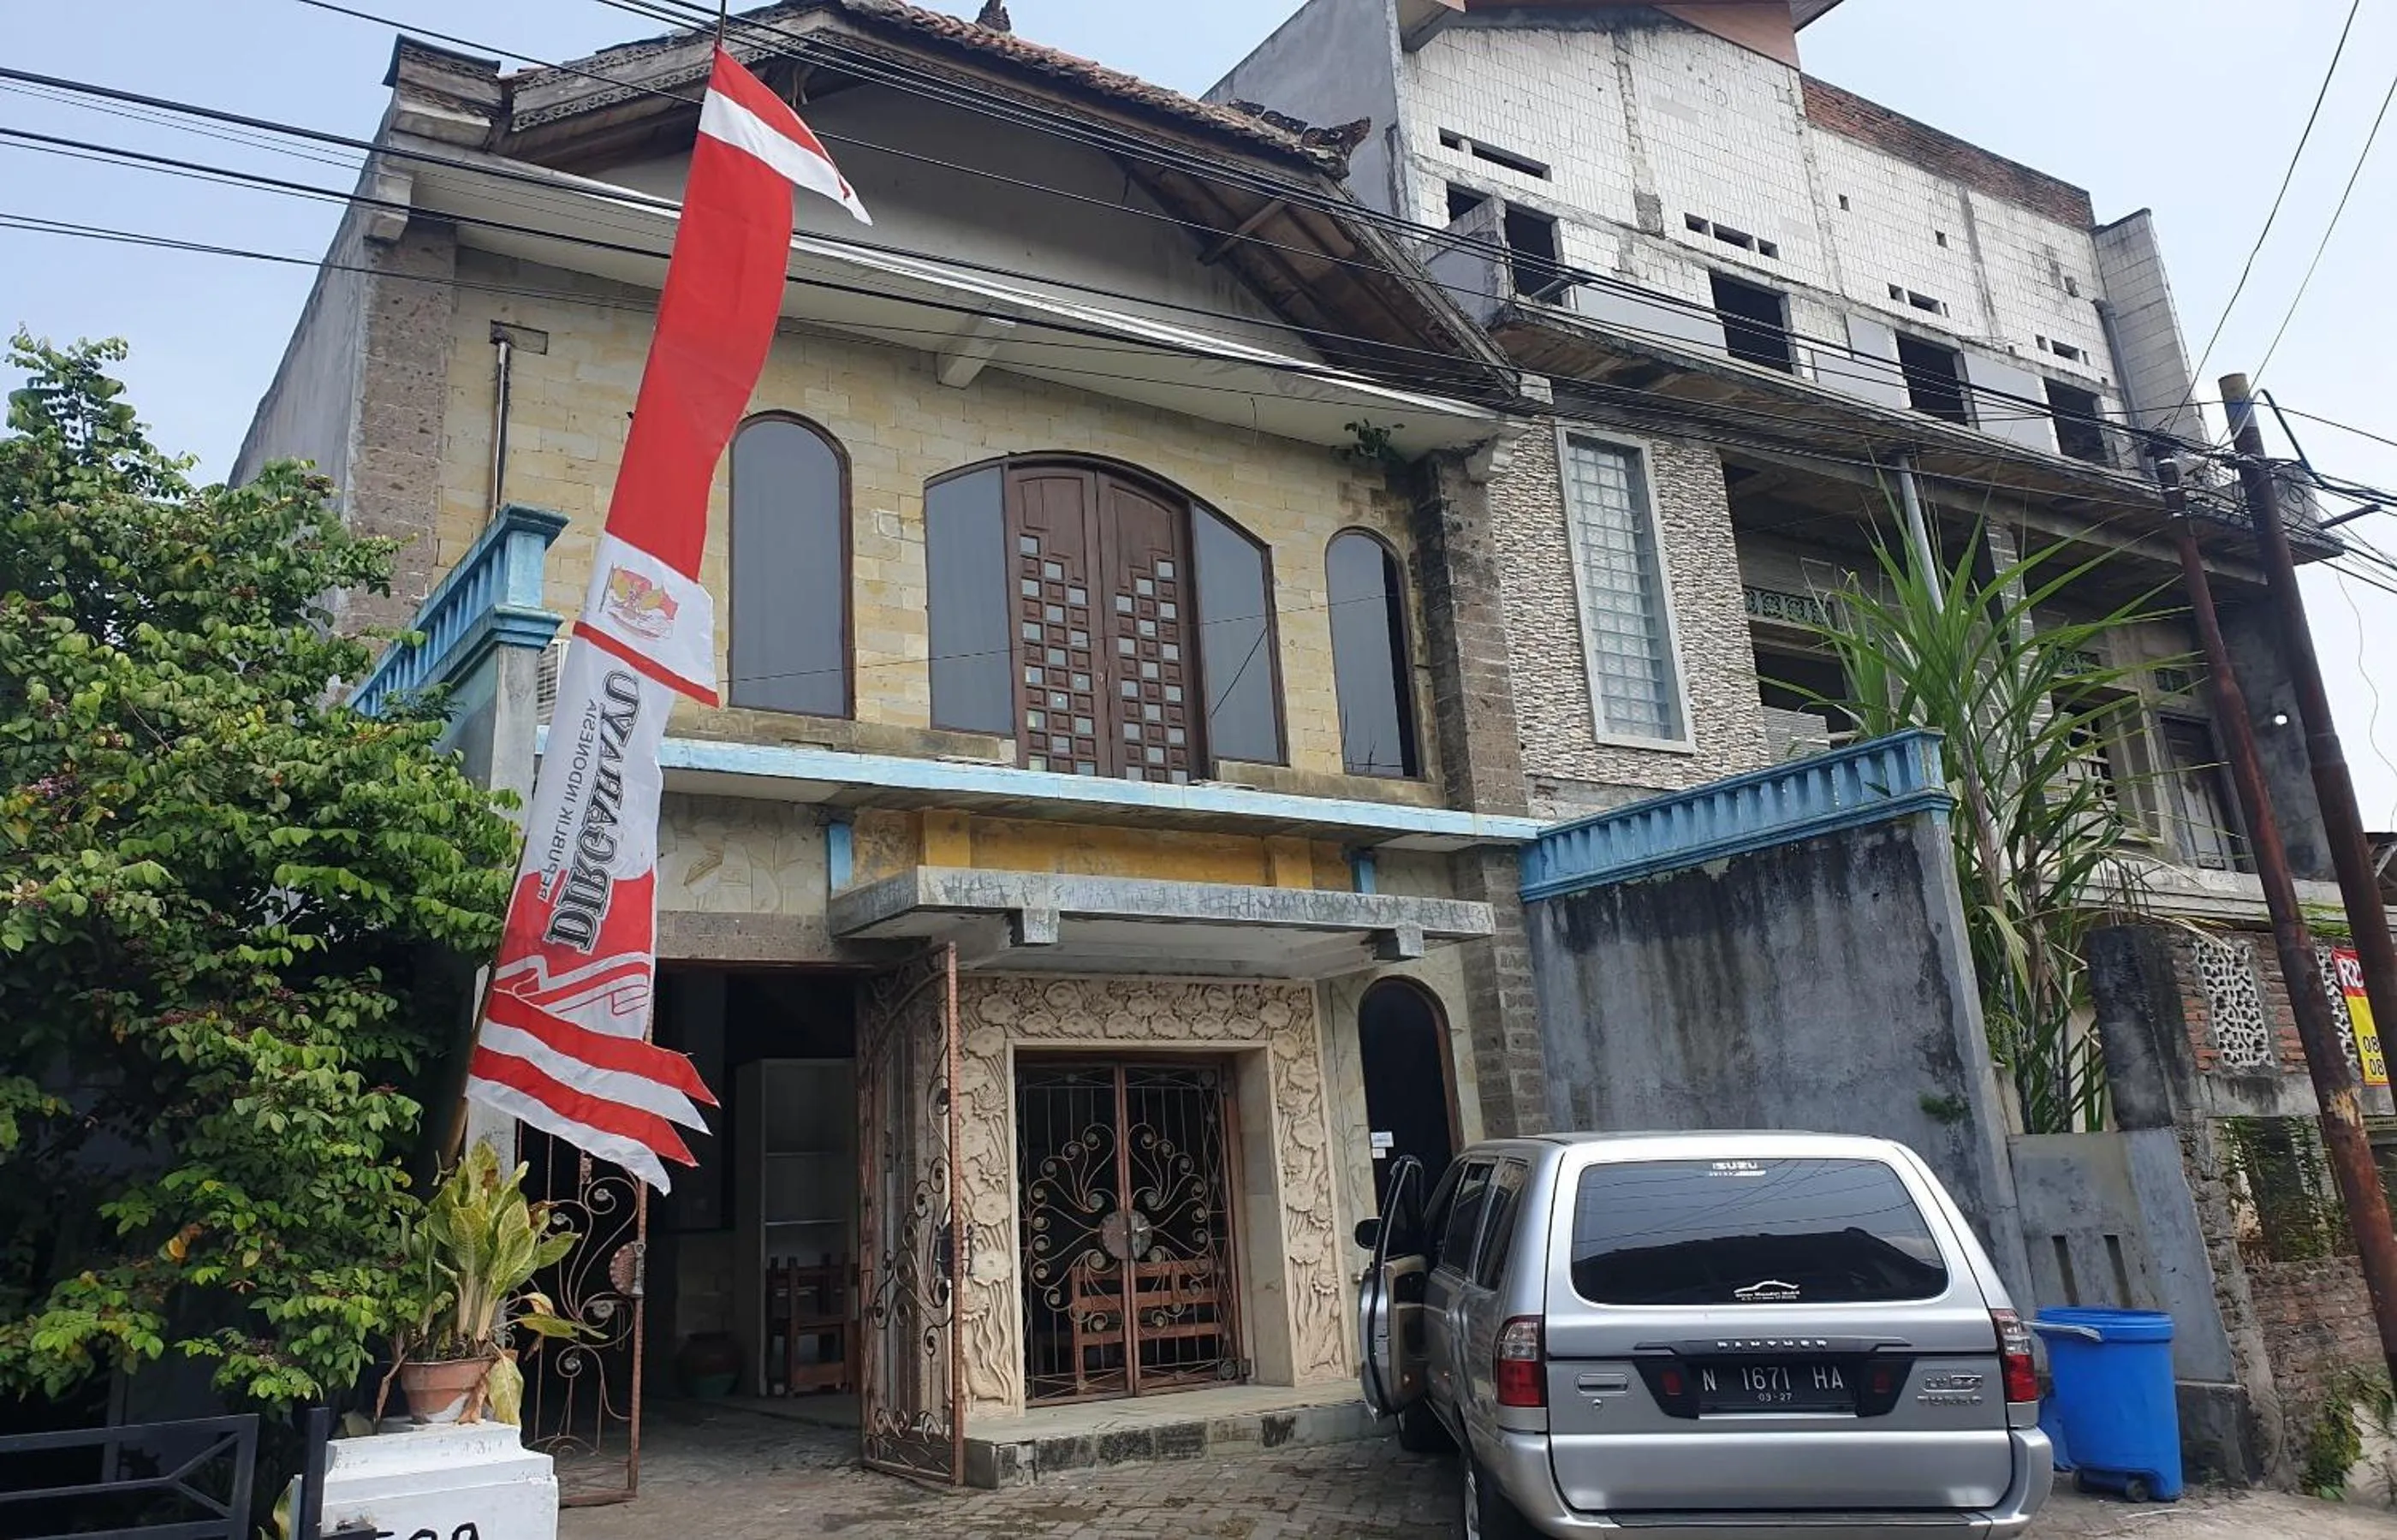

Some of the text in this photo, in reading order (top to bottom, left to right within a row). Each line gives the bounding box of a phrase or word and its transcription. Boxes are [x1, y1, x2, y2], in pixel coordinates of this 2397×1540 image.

[1702, 1367, 1844, 1391] N 1671 HA
